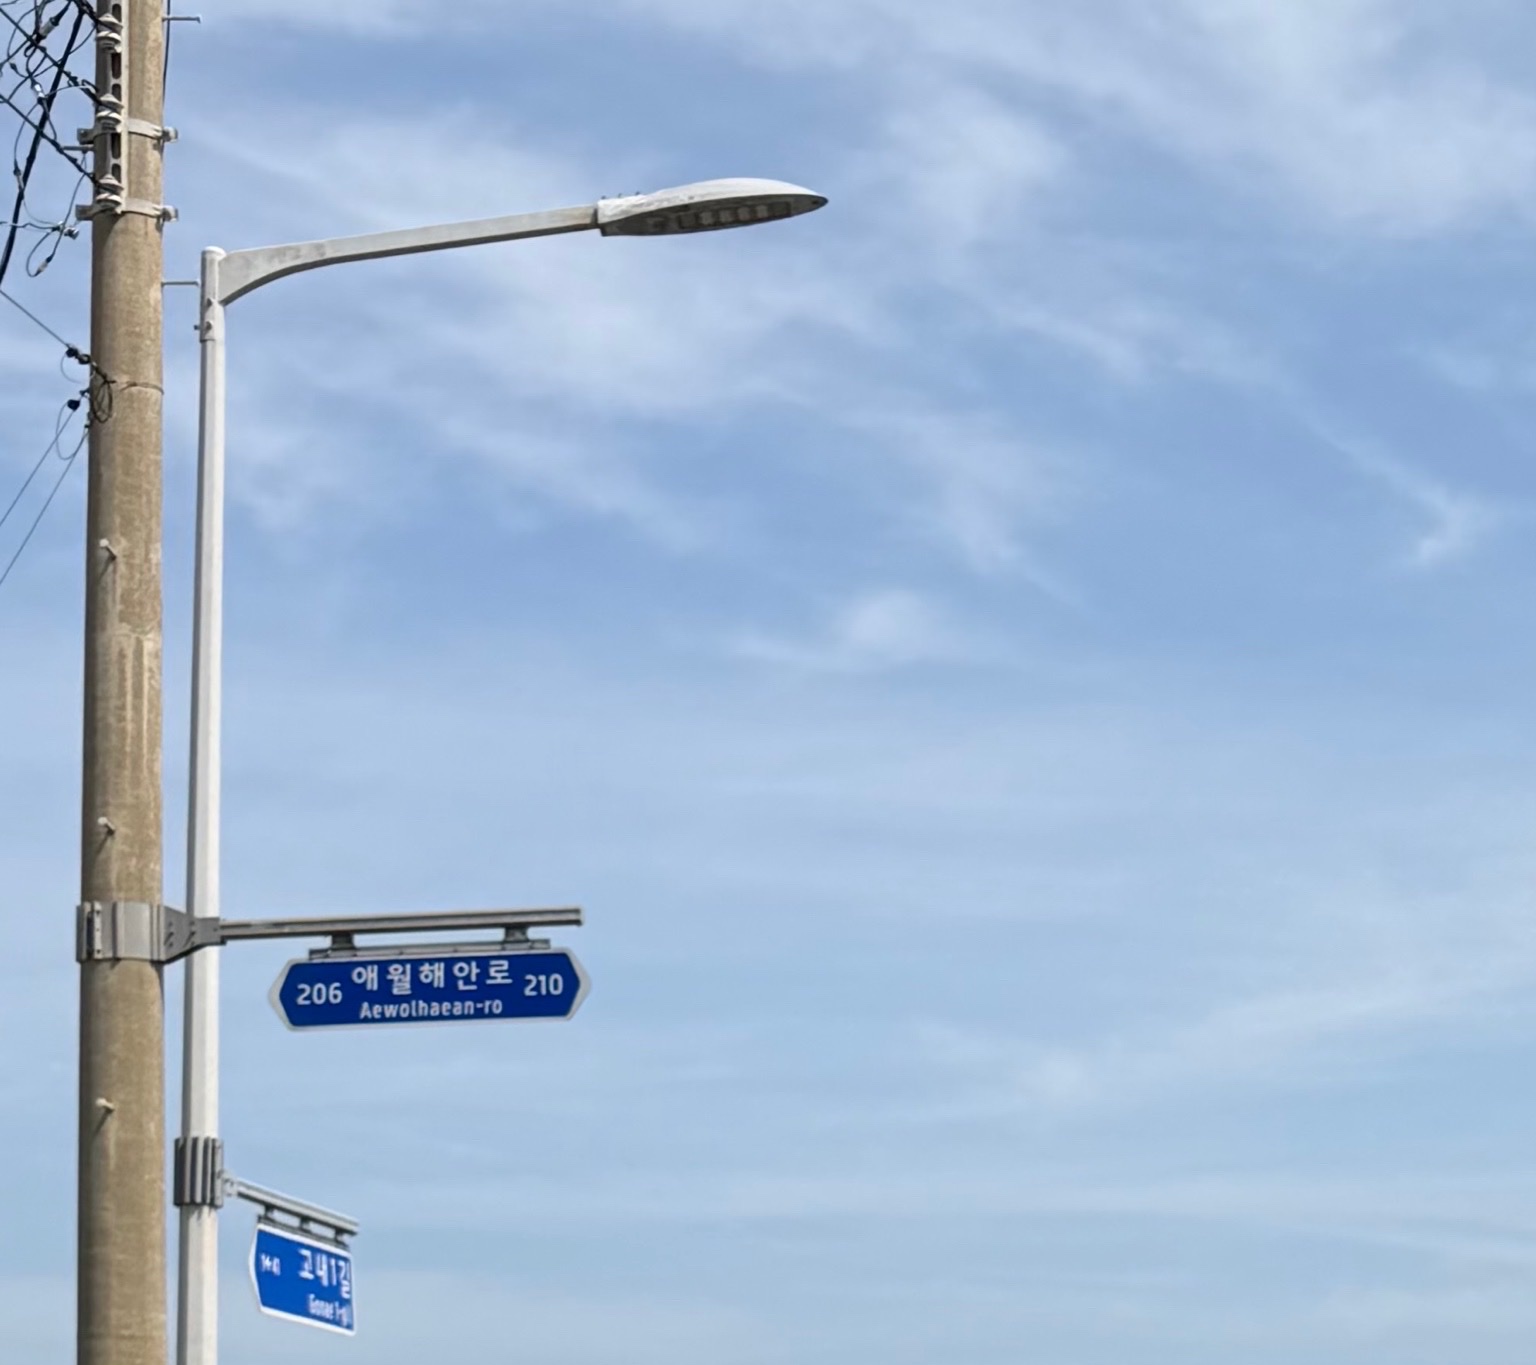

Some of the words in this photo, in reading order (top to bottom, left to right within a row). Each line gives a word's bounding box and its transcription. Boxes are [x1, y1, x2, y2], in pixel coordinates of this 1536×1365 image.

[352, 960, 512, 995] 애월해안로
[523, 973, 564, 996] 210
[296, 982, 343, 1005] 206
[360, 999, 503, 1019] Aewolhaean-ro
[298, 1249, 351, 1298] 고내1길
